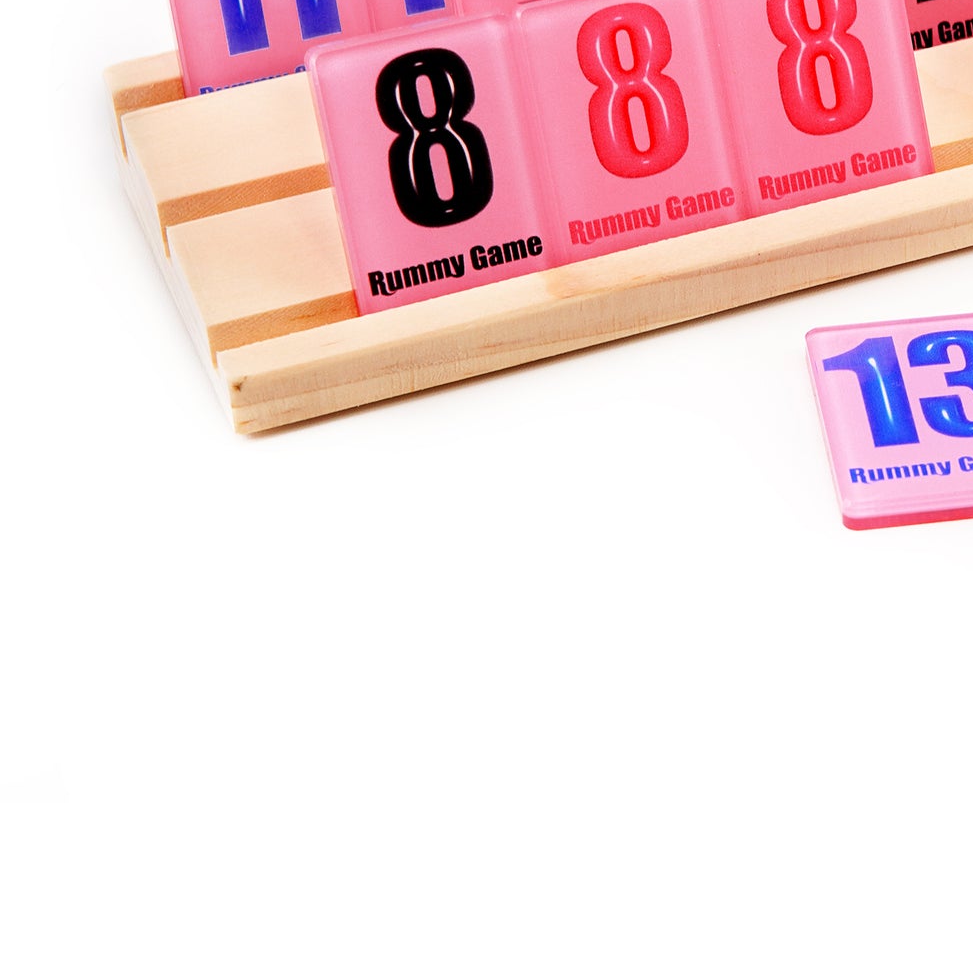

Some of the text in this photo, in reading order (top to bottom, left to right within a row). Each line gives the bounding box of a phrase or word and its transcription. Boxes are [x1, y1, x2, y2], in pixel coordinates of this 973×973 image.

[575, 1, 689, 179] 8
[375, 46, 494, 228] 8
[758, 141, 917, 200] Rummy Game
[568, 186, 736, 246] Rummy Game
[368, 235, 544, 297] Rummy Game
[849, 459, 952, 485] Rummy
